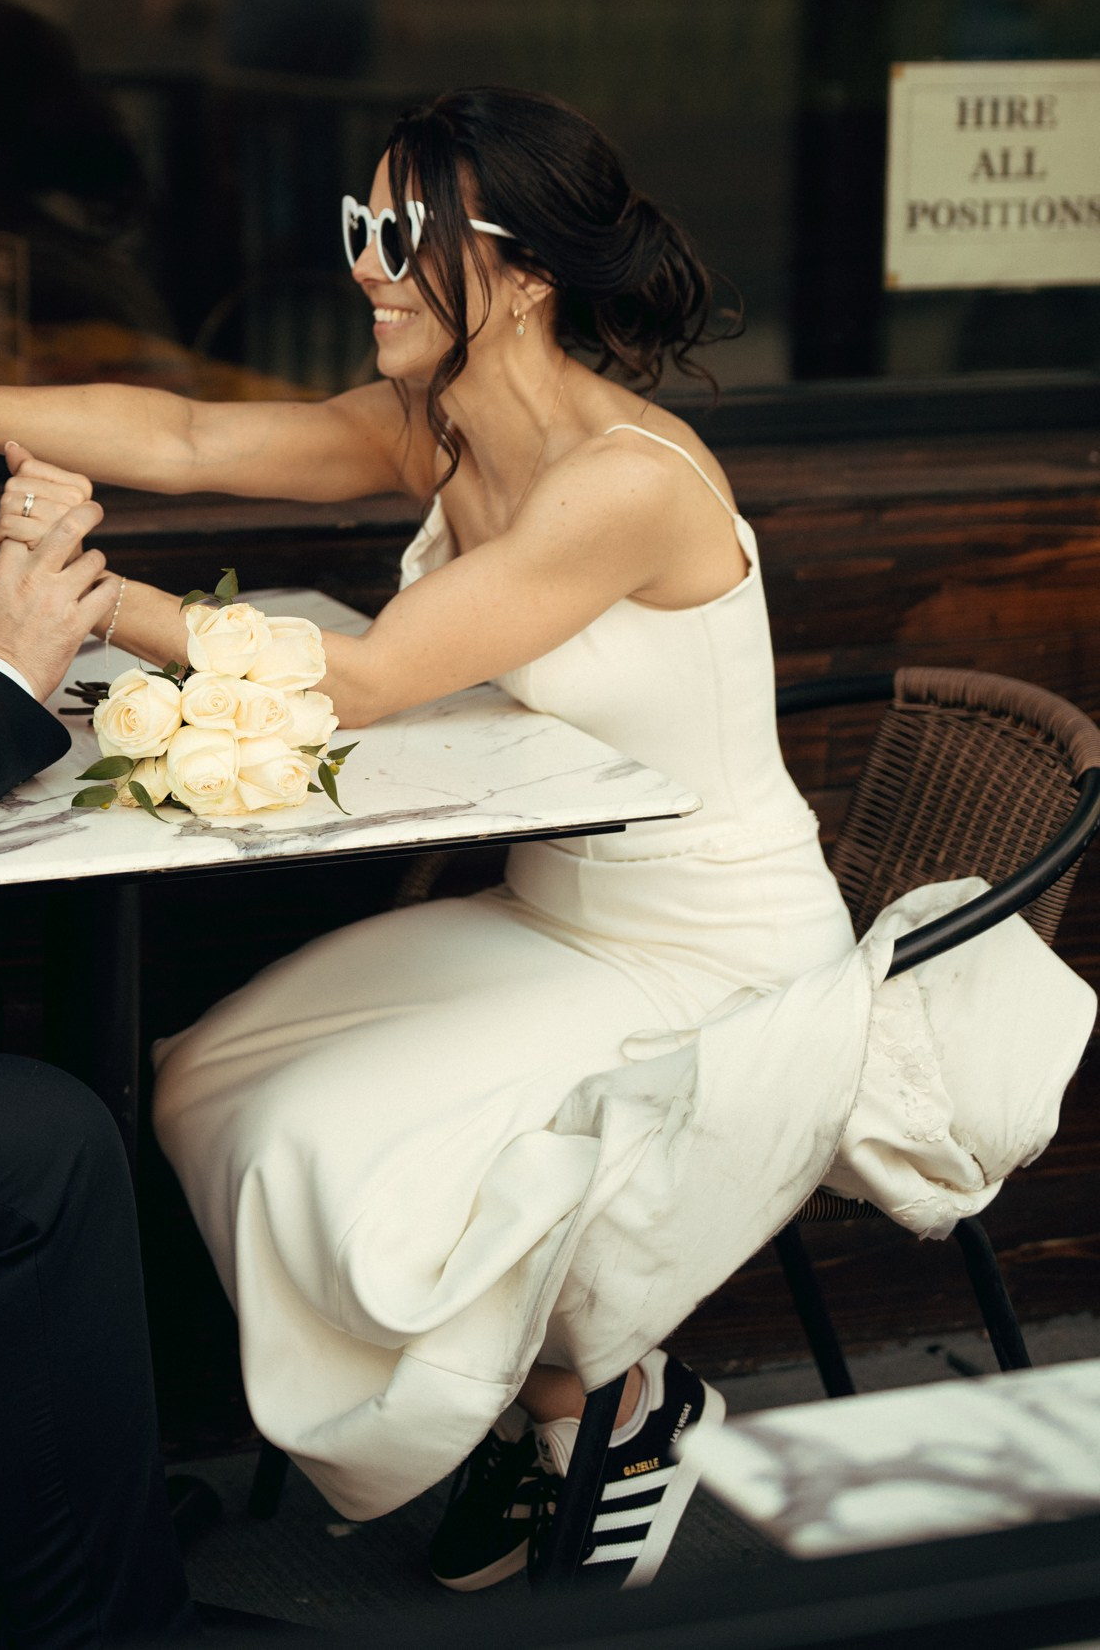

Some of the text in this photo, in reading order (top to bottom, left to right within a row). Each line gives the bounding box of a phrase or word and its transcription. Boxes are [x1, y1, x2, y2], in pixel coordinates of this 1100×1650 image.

[955, 95, 1058, 131] HIRE
[970, 146, 1047, 183] ALL
[623, 1457, 659, 1477] GAZELLE
